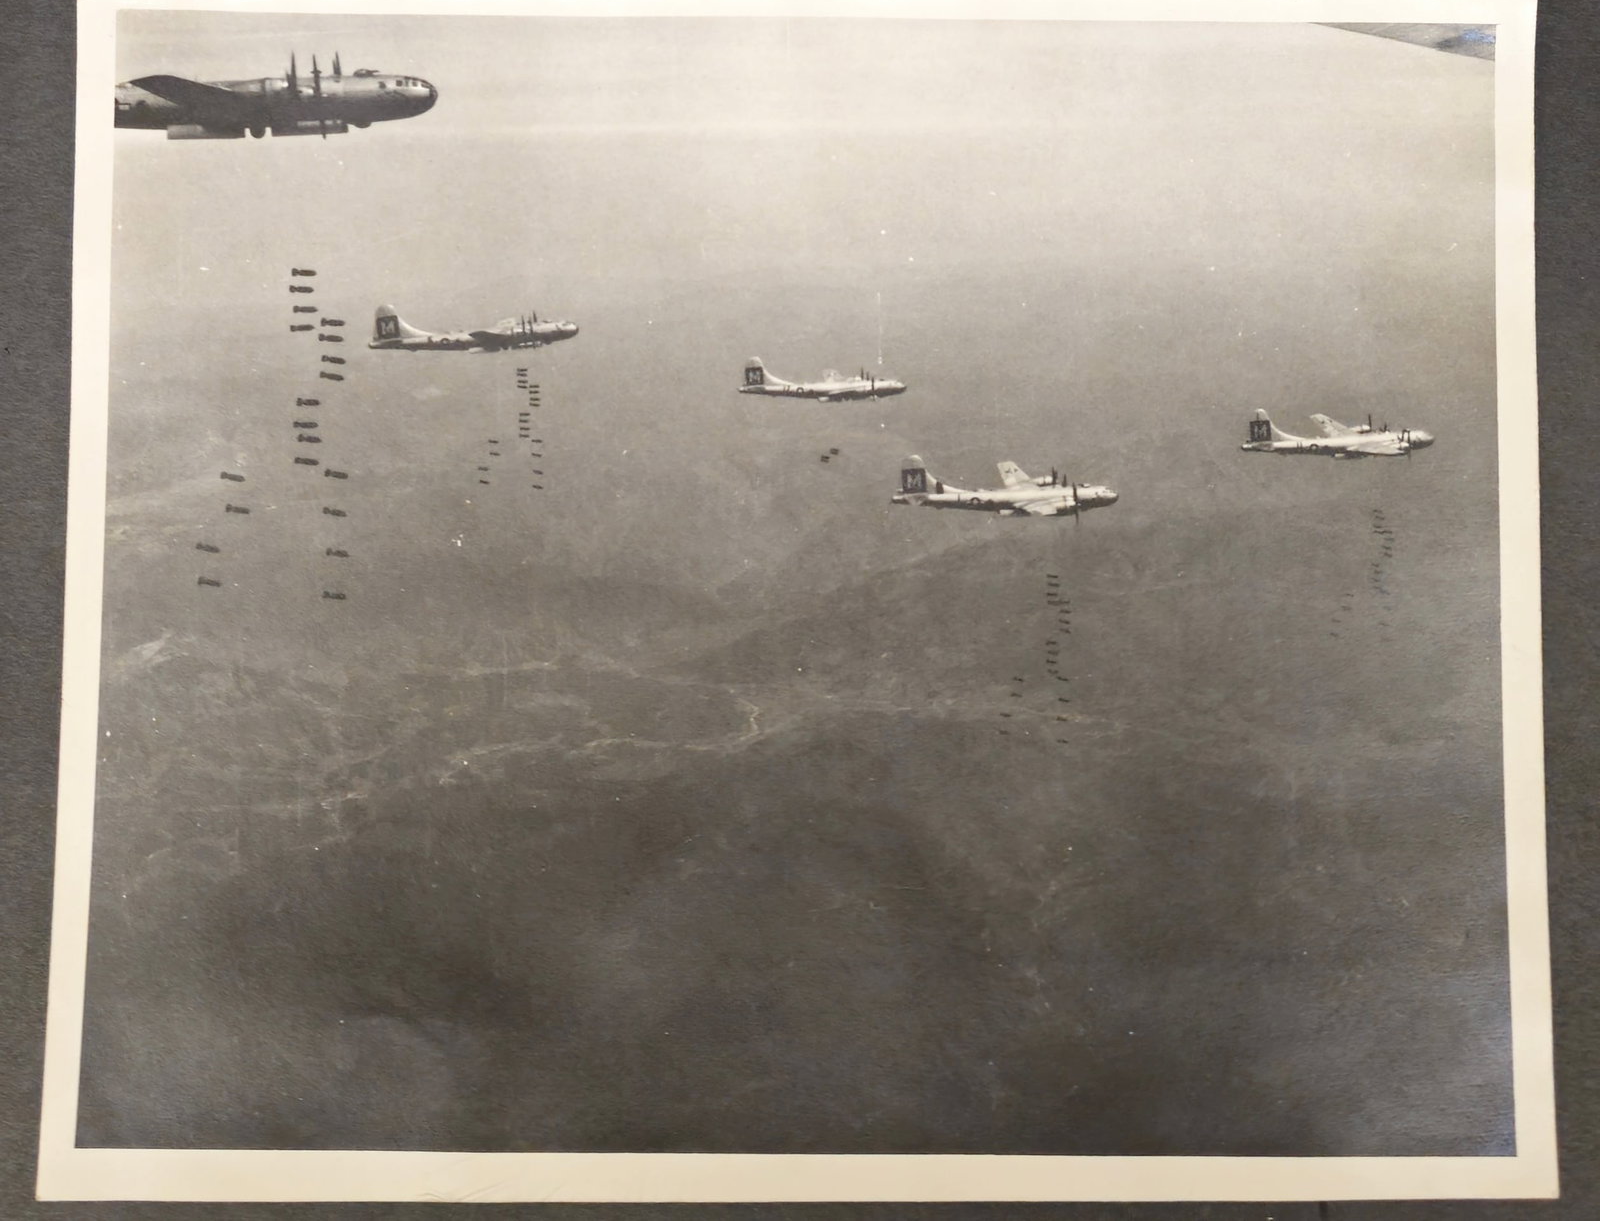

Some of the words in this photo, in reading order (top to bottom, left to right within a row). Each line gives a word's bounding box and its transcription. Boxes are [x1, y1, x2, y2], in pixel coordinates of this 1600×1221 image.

[379, 319, 396, 336] M
[1252, 423, 1268, 439] M
[905, 472, 923, 490] M
